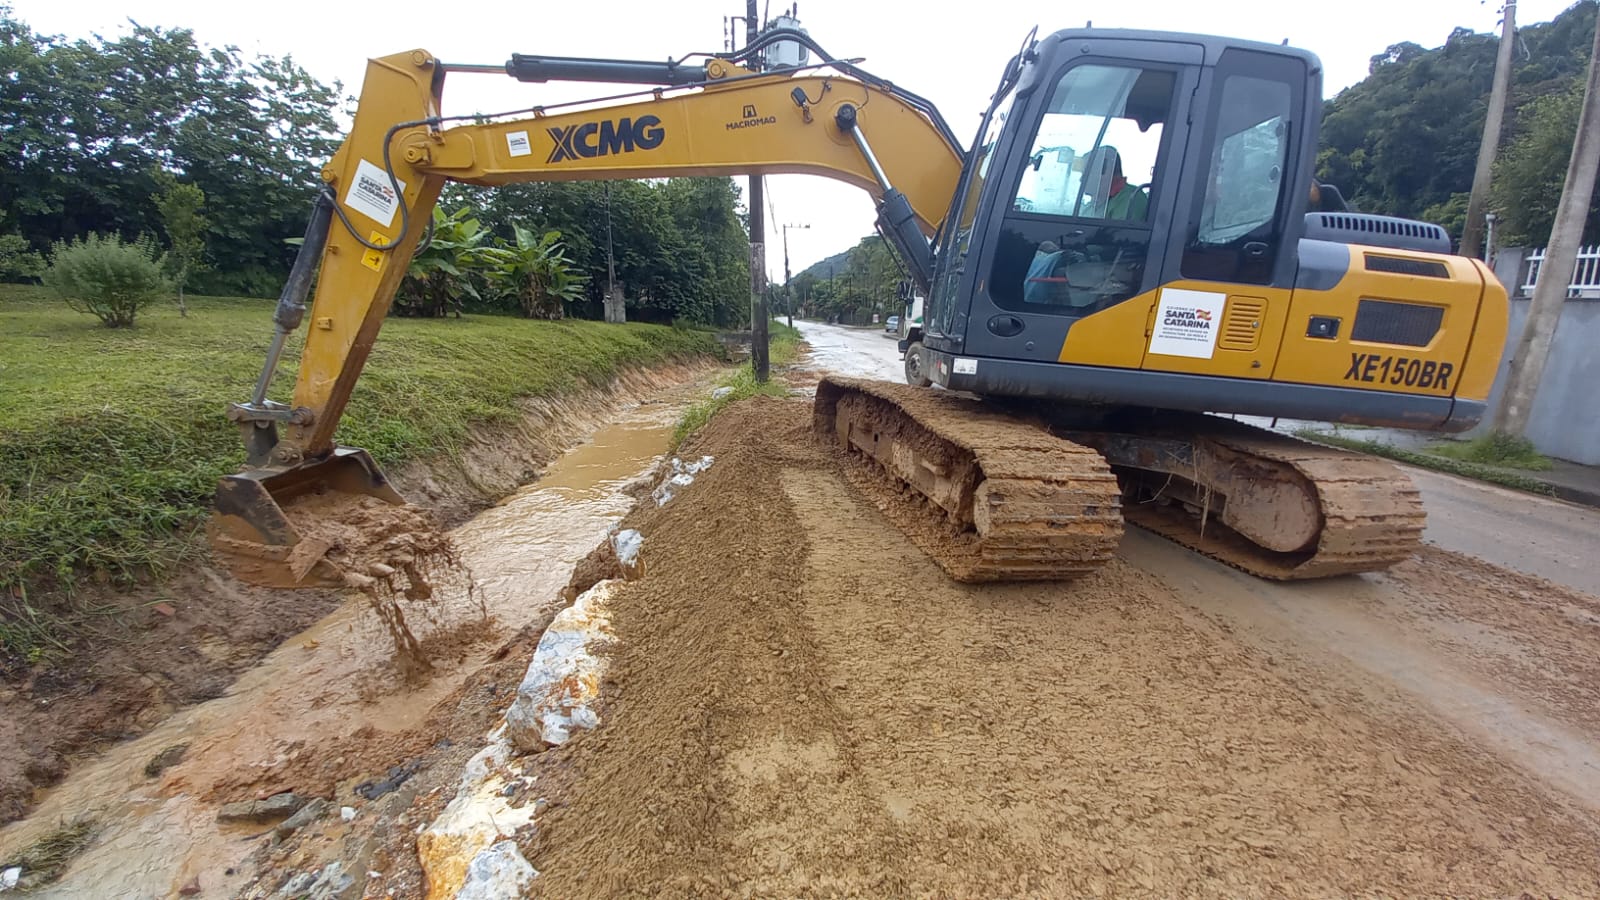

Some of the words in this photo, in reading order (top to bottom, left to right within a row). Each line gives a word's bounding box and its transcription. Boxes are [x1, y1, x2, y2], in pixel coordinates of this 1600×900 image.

[726, 116, 776, 131] MACROMAQ
[545, 114, 665, 164] XCMG
[360, 176, 382, 193] SANTA
[358, 182, 392, 205] CATARINA
[1163, 318, 1210, 329] CATARINA
[1165, 310, 1196, 320] SANTA
[1344, 352, 1454, 390] XE150BR
